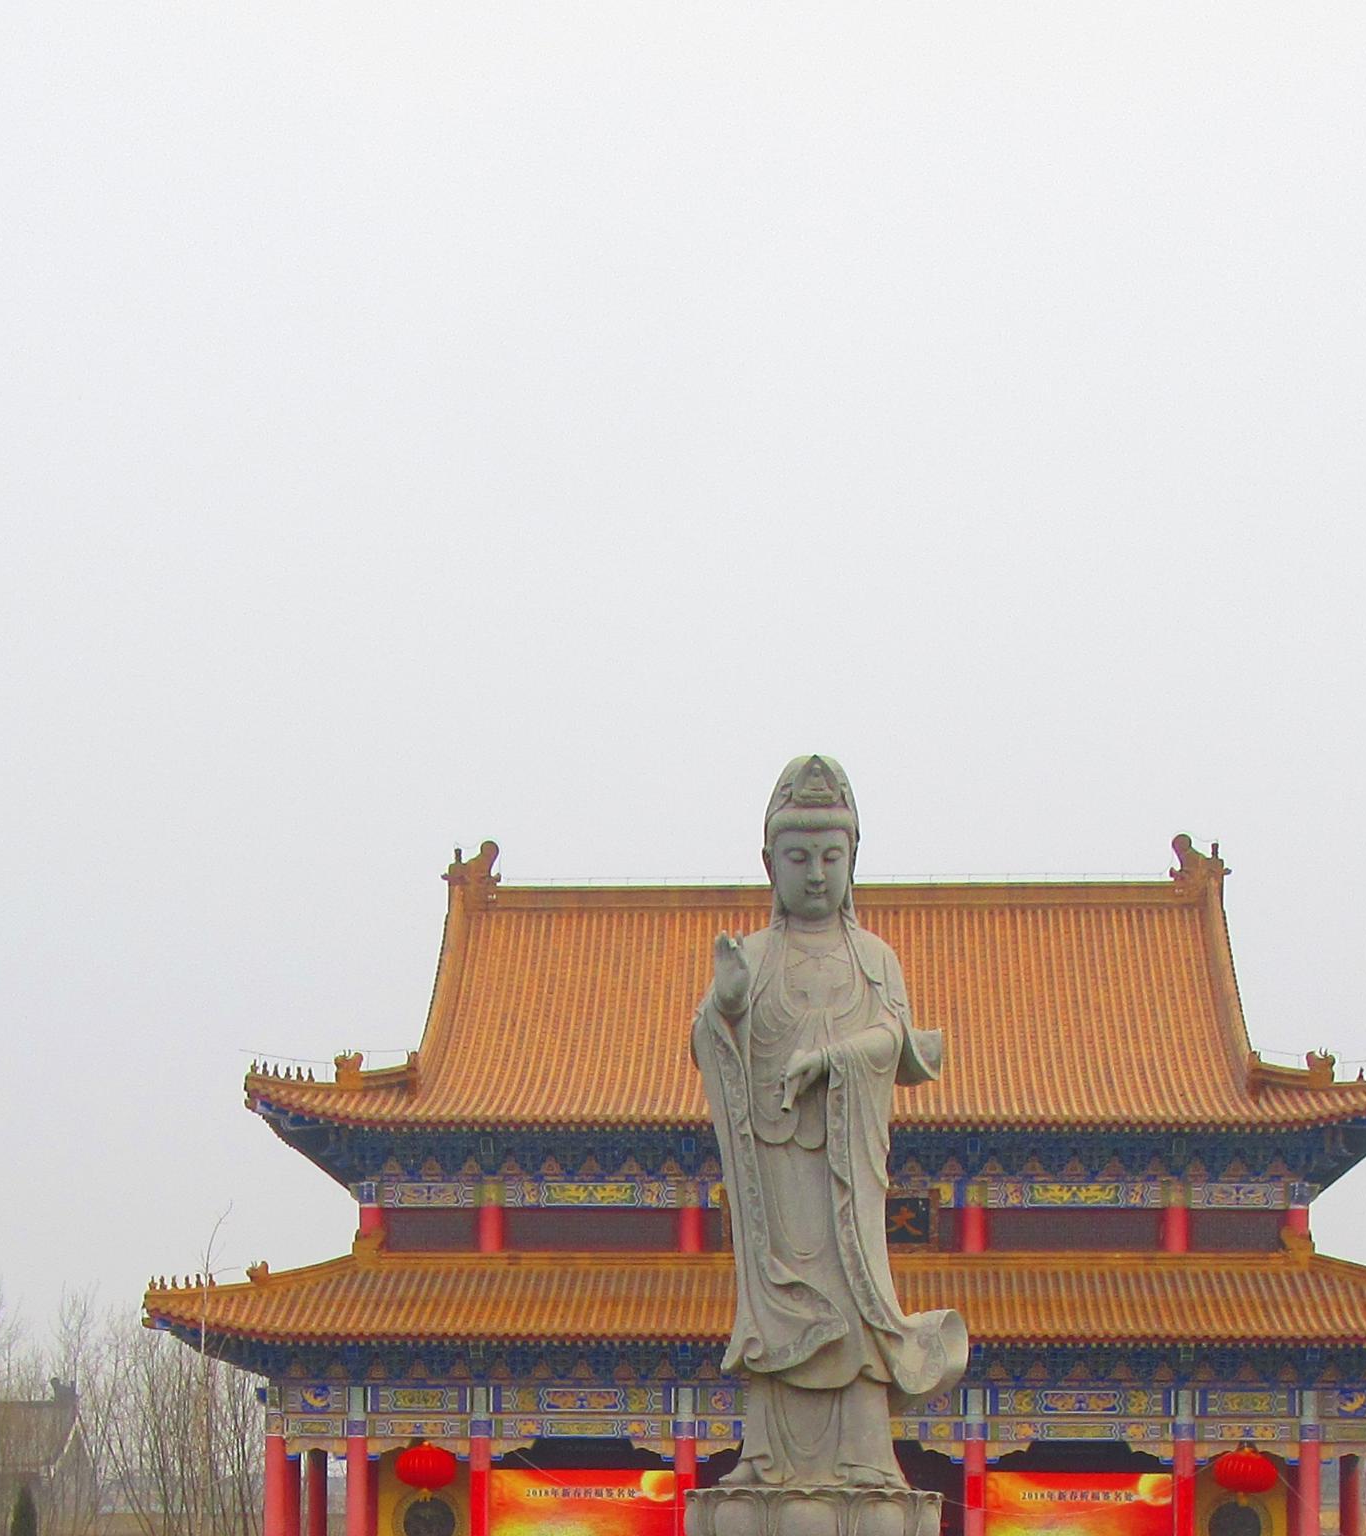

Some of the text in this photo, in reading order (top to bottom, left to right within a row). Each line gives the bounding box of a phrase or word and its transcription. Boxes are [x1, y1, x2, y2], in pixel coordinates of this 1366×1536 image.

[525, 1486, 636, 1499] 2018年新春祈福签名处
[1021, 1490, 1134, 1502] 2018年新春祈福签名处
